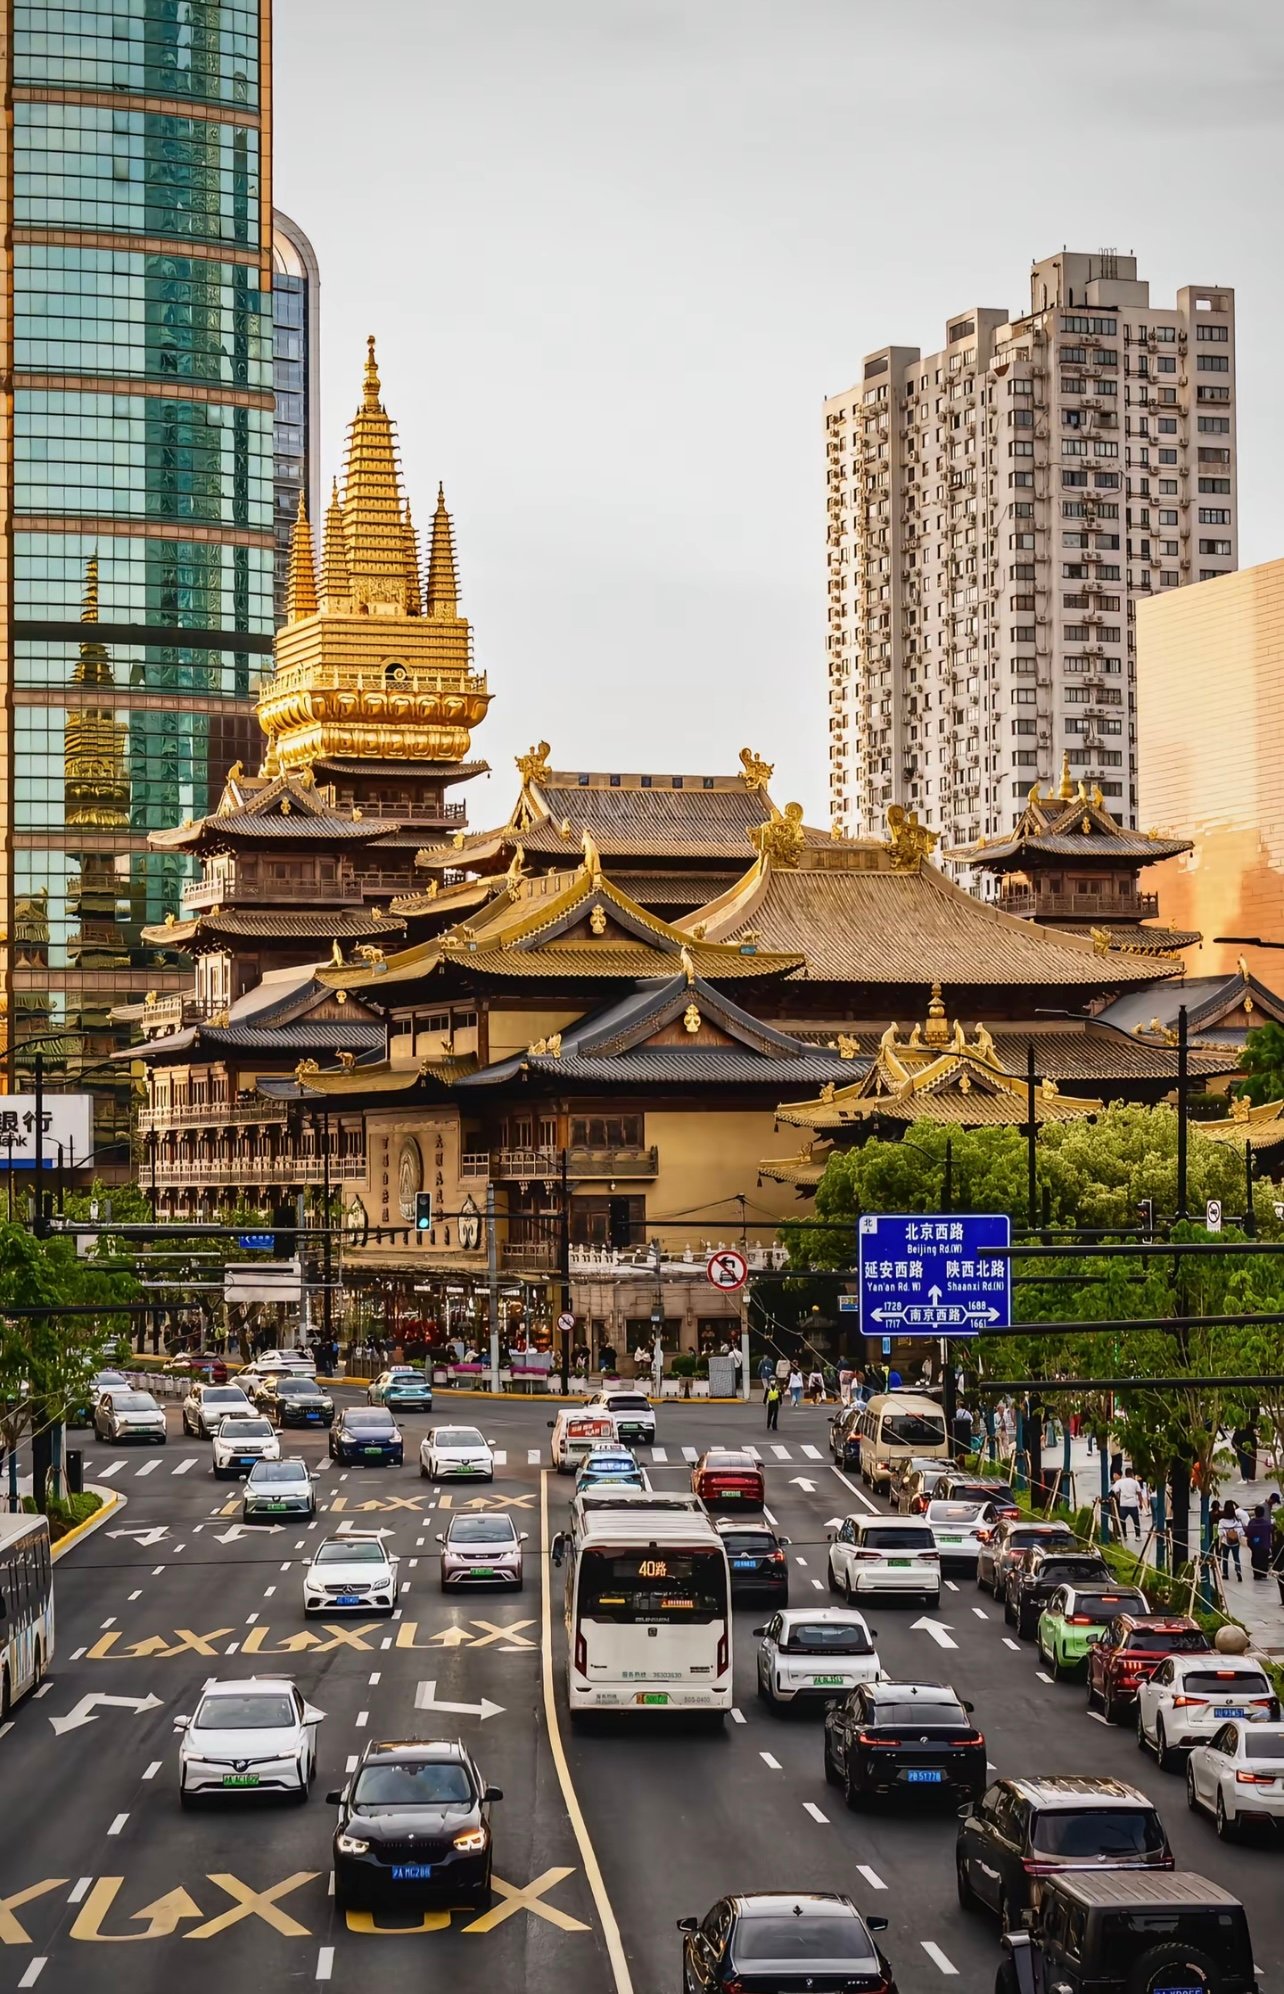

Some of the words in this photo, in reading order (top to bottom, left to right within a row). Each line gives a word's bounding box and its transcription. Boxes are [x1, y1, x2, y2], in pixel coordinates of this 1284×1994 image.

[0, 1135, 27, 1147] ank
[864, 1218, 873, 1227] 北
[905, 1222, 964, 1241] 北京西路
[907, 1244, 937, 1256] Beijing
[865, 1261, 923, 1279] 延安西路
[946, 1260, 1005, 1278] 陕西北路
[867, 1282, 896, 1292] Yan'an
[947, 1281, 980, 1291] Shaanxi
[884, 1301, 902, 1311] 1728
[968, 1301, 987, 1310] 1688
[910, 1308, 961, 1322] 南京西路
[885, 1319, 901, 1328] 1717
[970, 1319, 987, 1328] 1661
[638, 1560, 668, 1577] 40路
